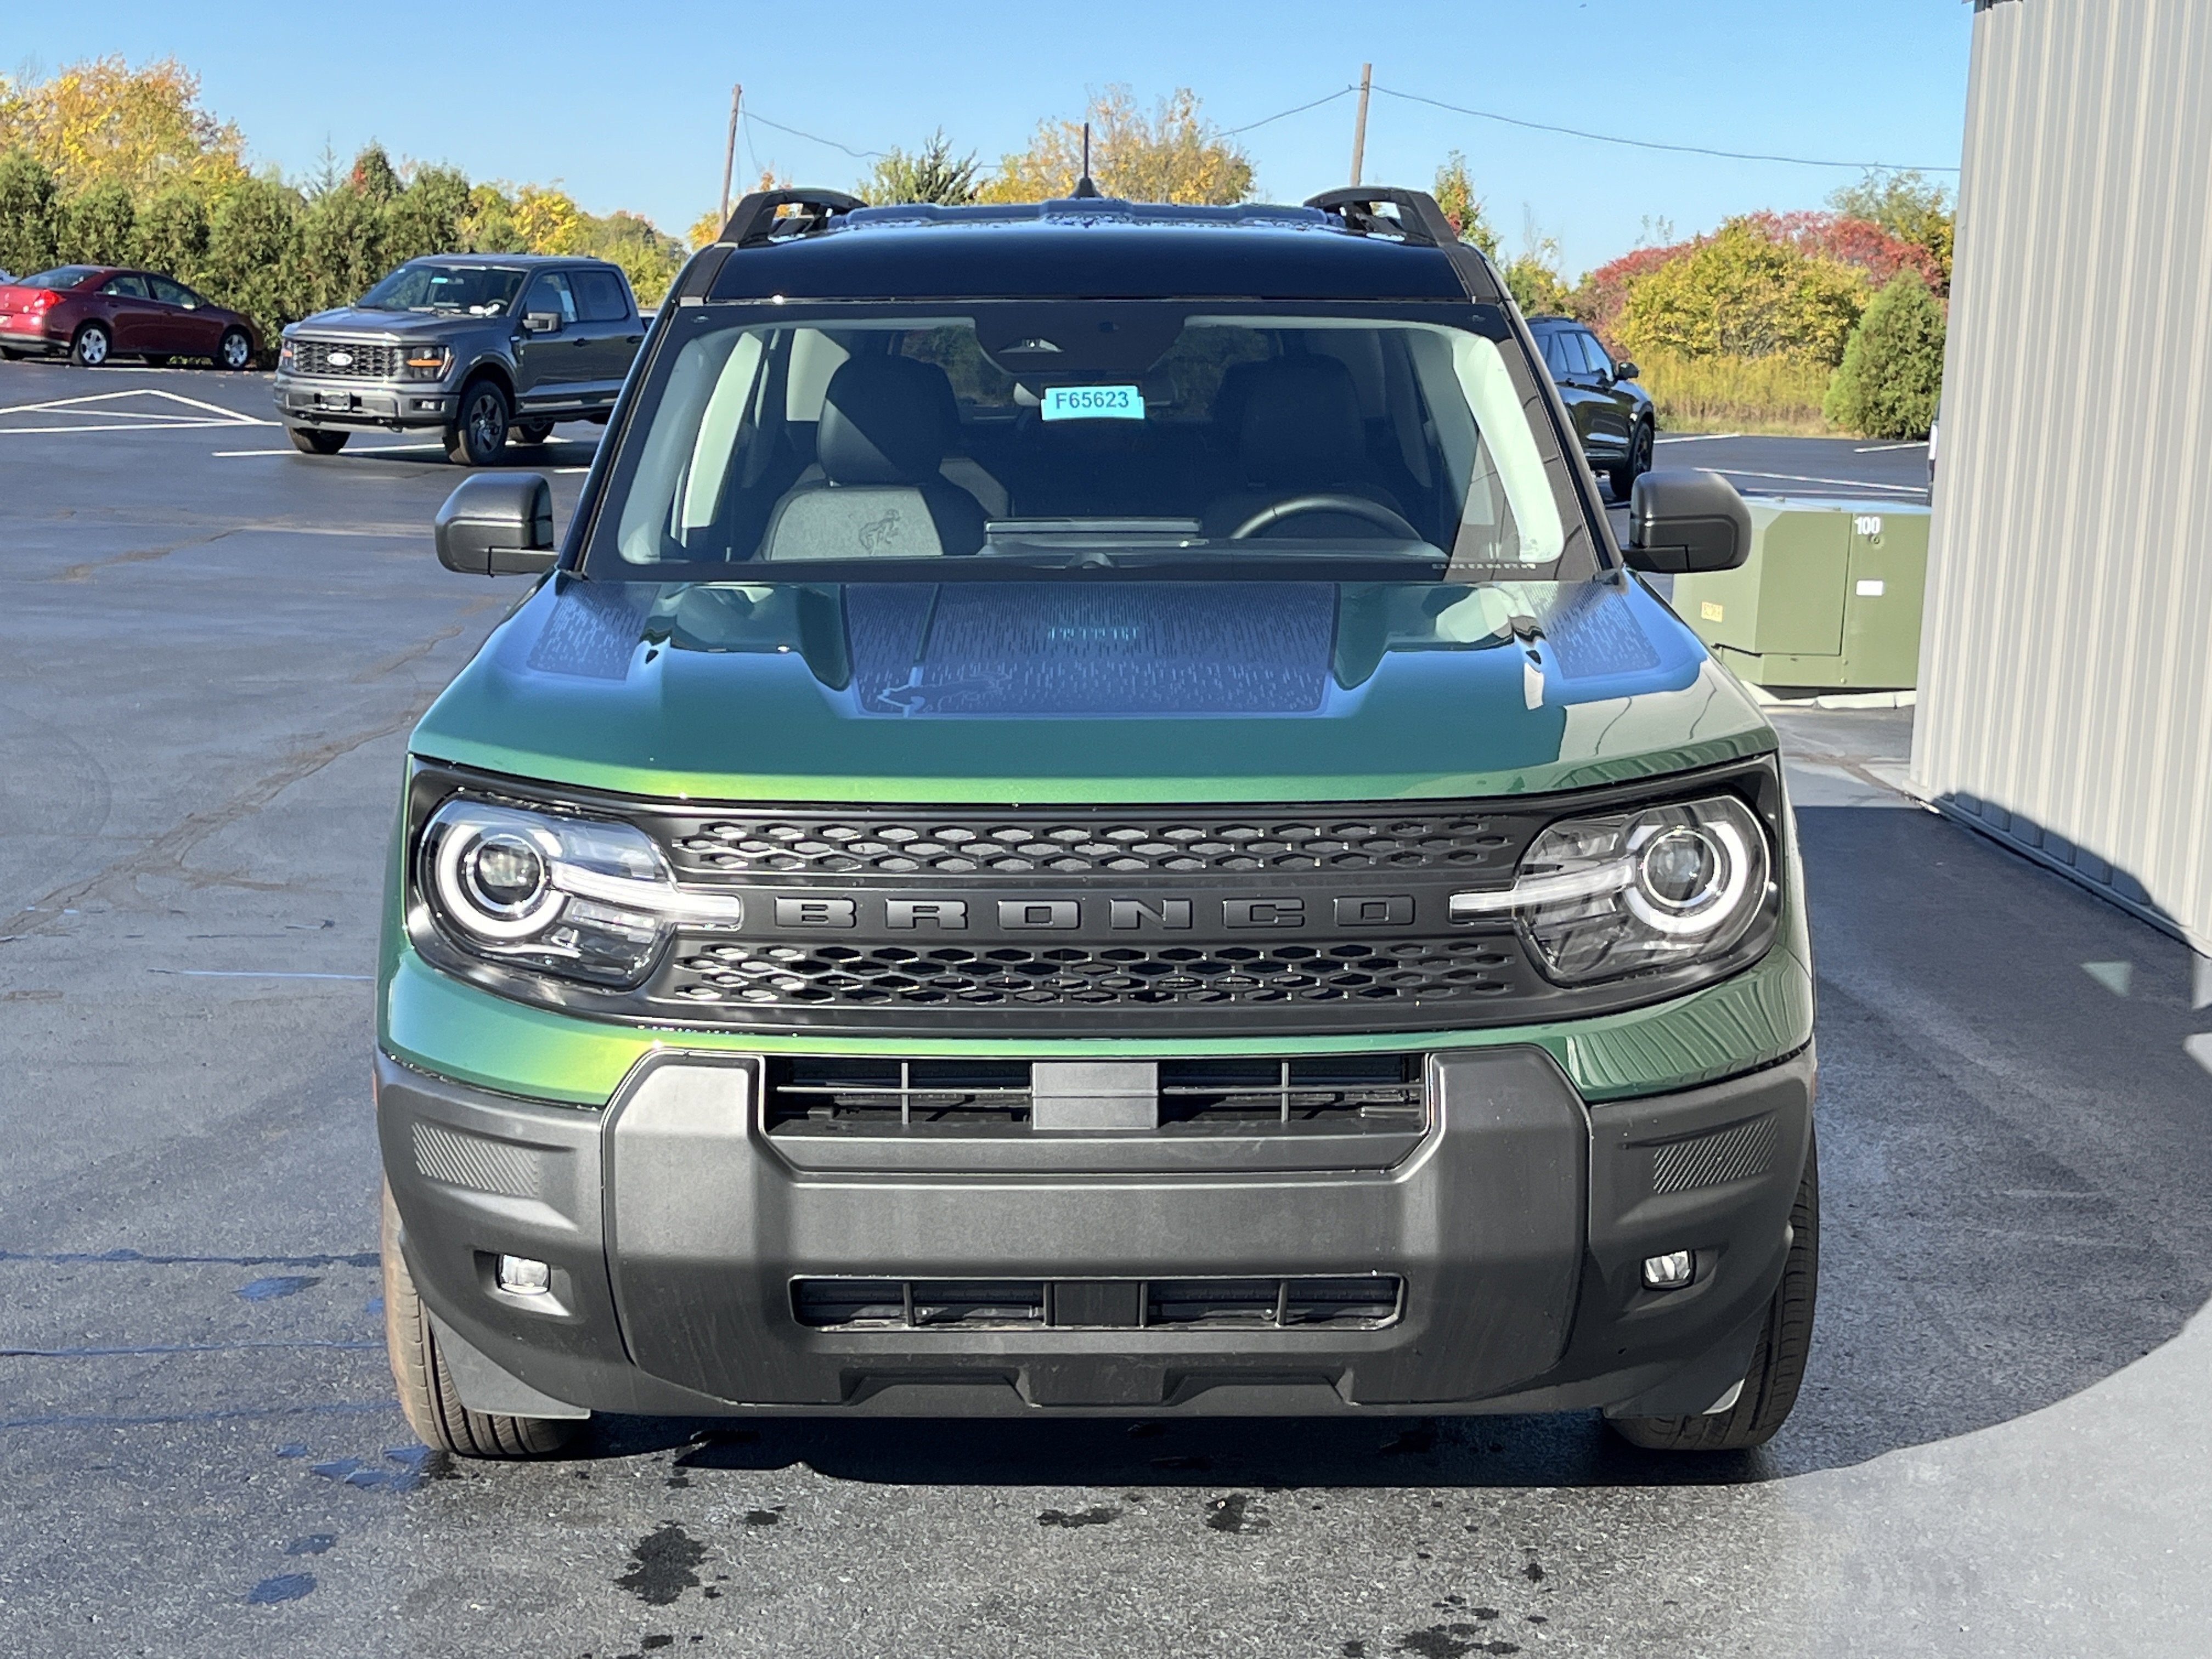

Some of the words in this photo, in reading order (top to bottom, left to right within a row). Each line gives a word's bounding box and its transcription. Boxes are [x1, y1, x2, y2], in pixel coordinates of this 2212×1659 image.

[1056, 391, 1129, 409] F65623
[1854, 516, 1881, 535] 100
[775, 895, 1415, 929] BRONCO
